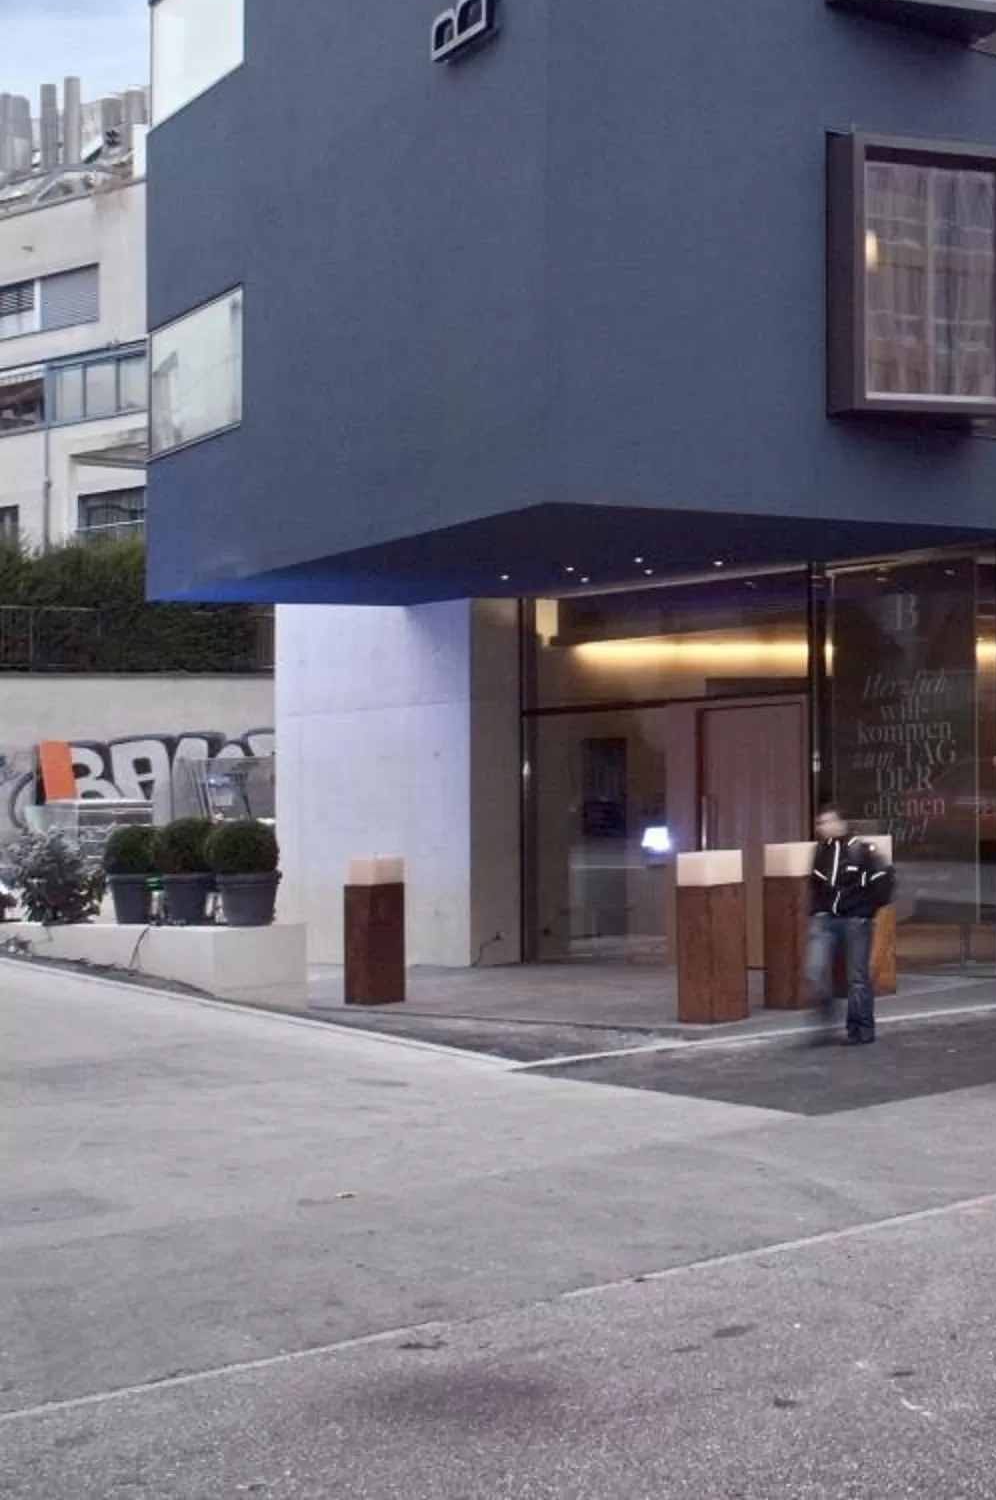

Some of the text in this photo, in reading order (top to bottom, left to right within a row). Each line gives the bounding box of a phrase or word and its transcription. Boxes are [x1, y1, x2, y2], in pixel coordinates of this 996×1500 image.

[856, 720, 952, 744] kommen
[903, 739, 957, 766] TAG
[875, 767, 934, 793] DER
[863, 792, 945, 818] offenen
